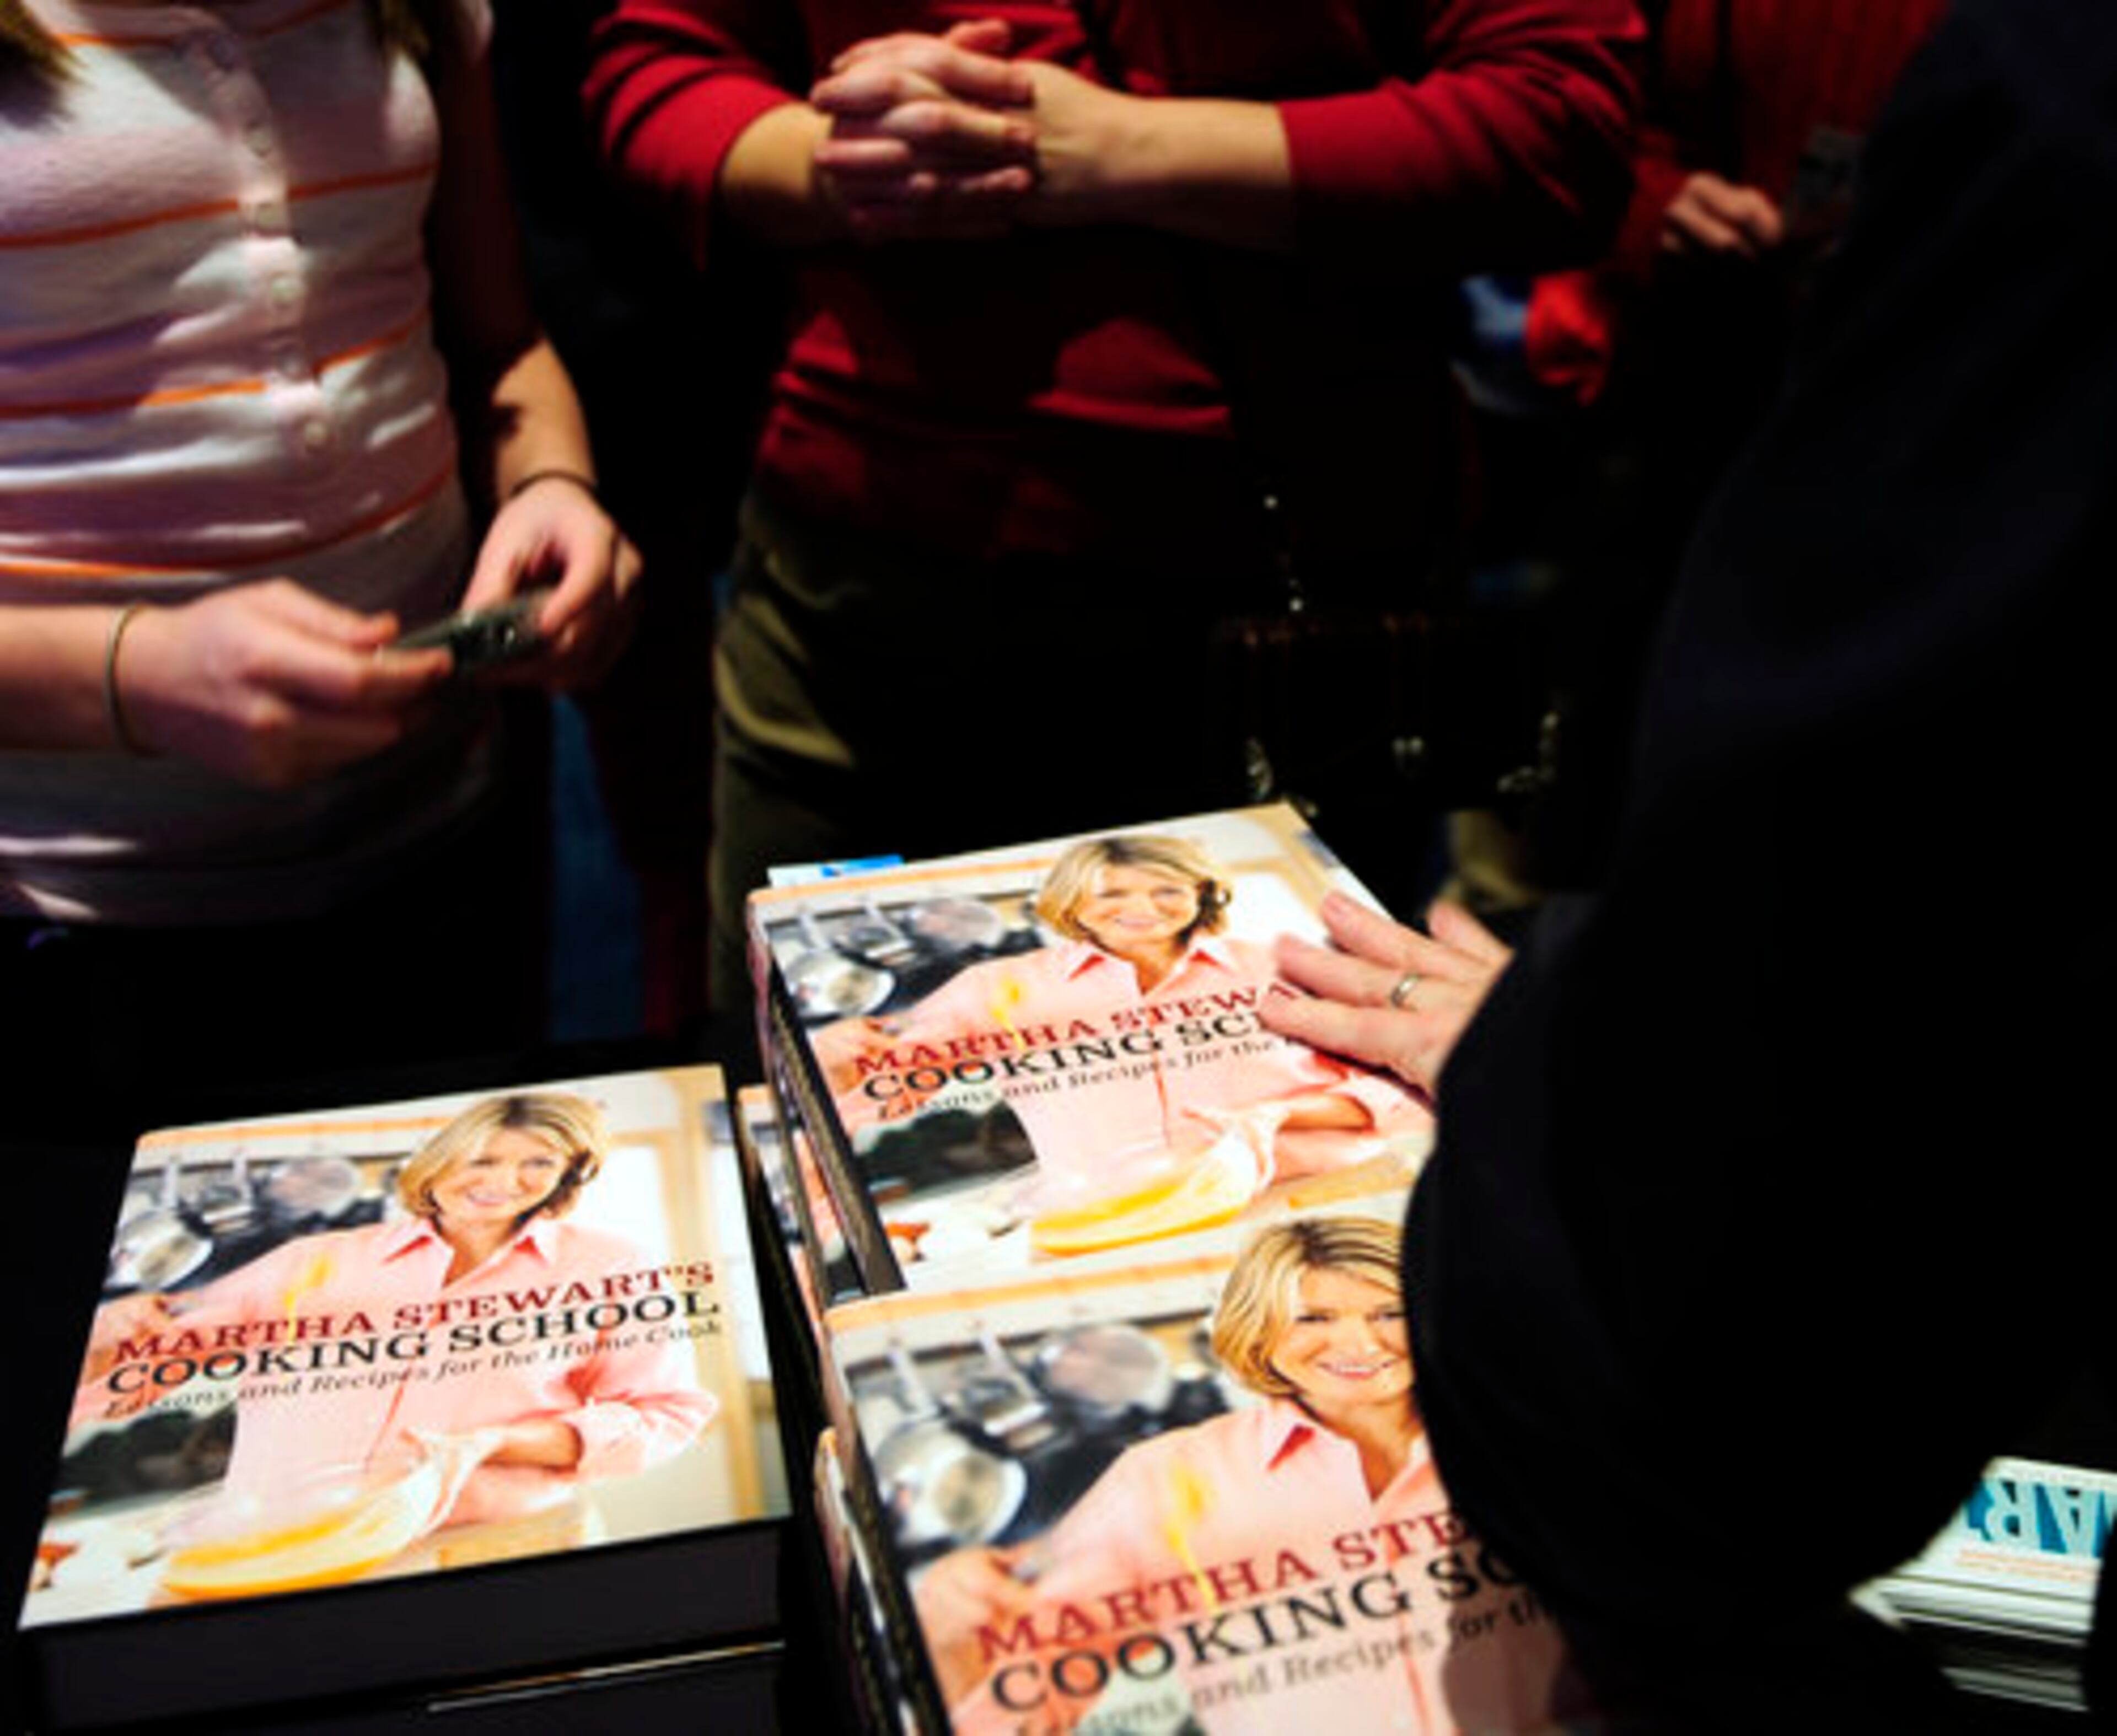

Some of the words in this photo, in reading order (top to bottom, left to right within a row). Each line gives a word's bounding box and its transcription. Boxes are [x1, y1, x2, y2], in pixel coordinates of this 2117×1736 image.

[854, 1018, 1098, 1076] MARTHA
[864, 1029, 1162, 1101] COOKING
[1003, 1077, 1061, 1098] and
[1068, 1058, 1177, 1088] Recipes
[1184, 1049, 1223, 1068] for
[1231, 1039, 1273, 1055] the
[106, 1330, 429, 1394] COOKING
[448, 1290, 719, 1353] SCHOOL
[113, 1311, 375, 1364] MARTHA
[394, 1262, 713, 1329] STEWART'S
[104, 1386, 233, 1418] Lessons
[238, 1377, 303, 1400] and
[309, 1365, 428, 1393] Recipes
[434, 1357, 481, 1382] for
[490, 1347, 540, 1368] the
[547, 1330, 640, 1359] Home
[645, 1318, 721, 1345] Cook
[974, 1547, 1319, 1664] MARTHA
[991, 1570, 1412, 1712] COOKING
[1193, 1665, 1269, 1710] and
[1281, 1628, 1434, 1686] Recipes
